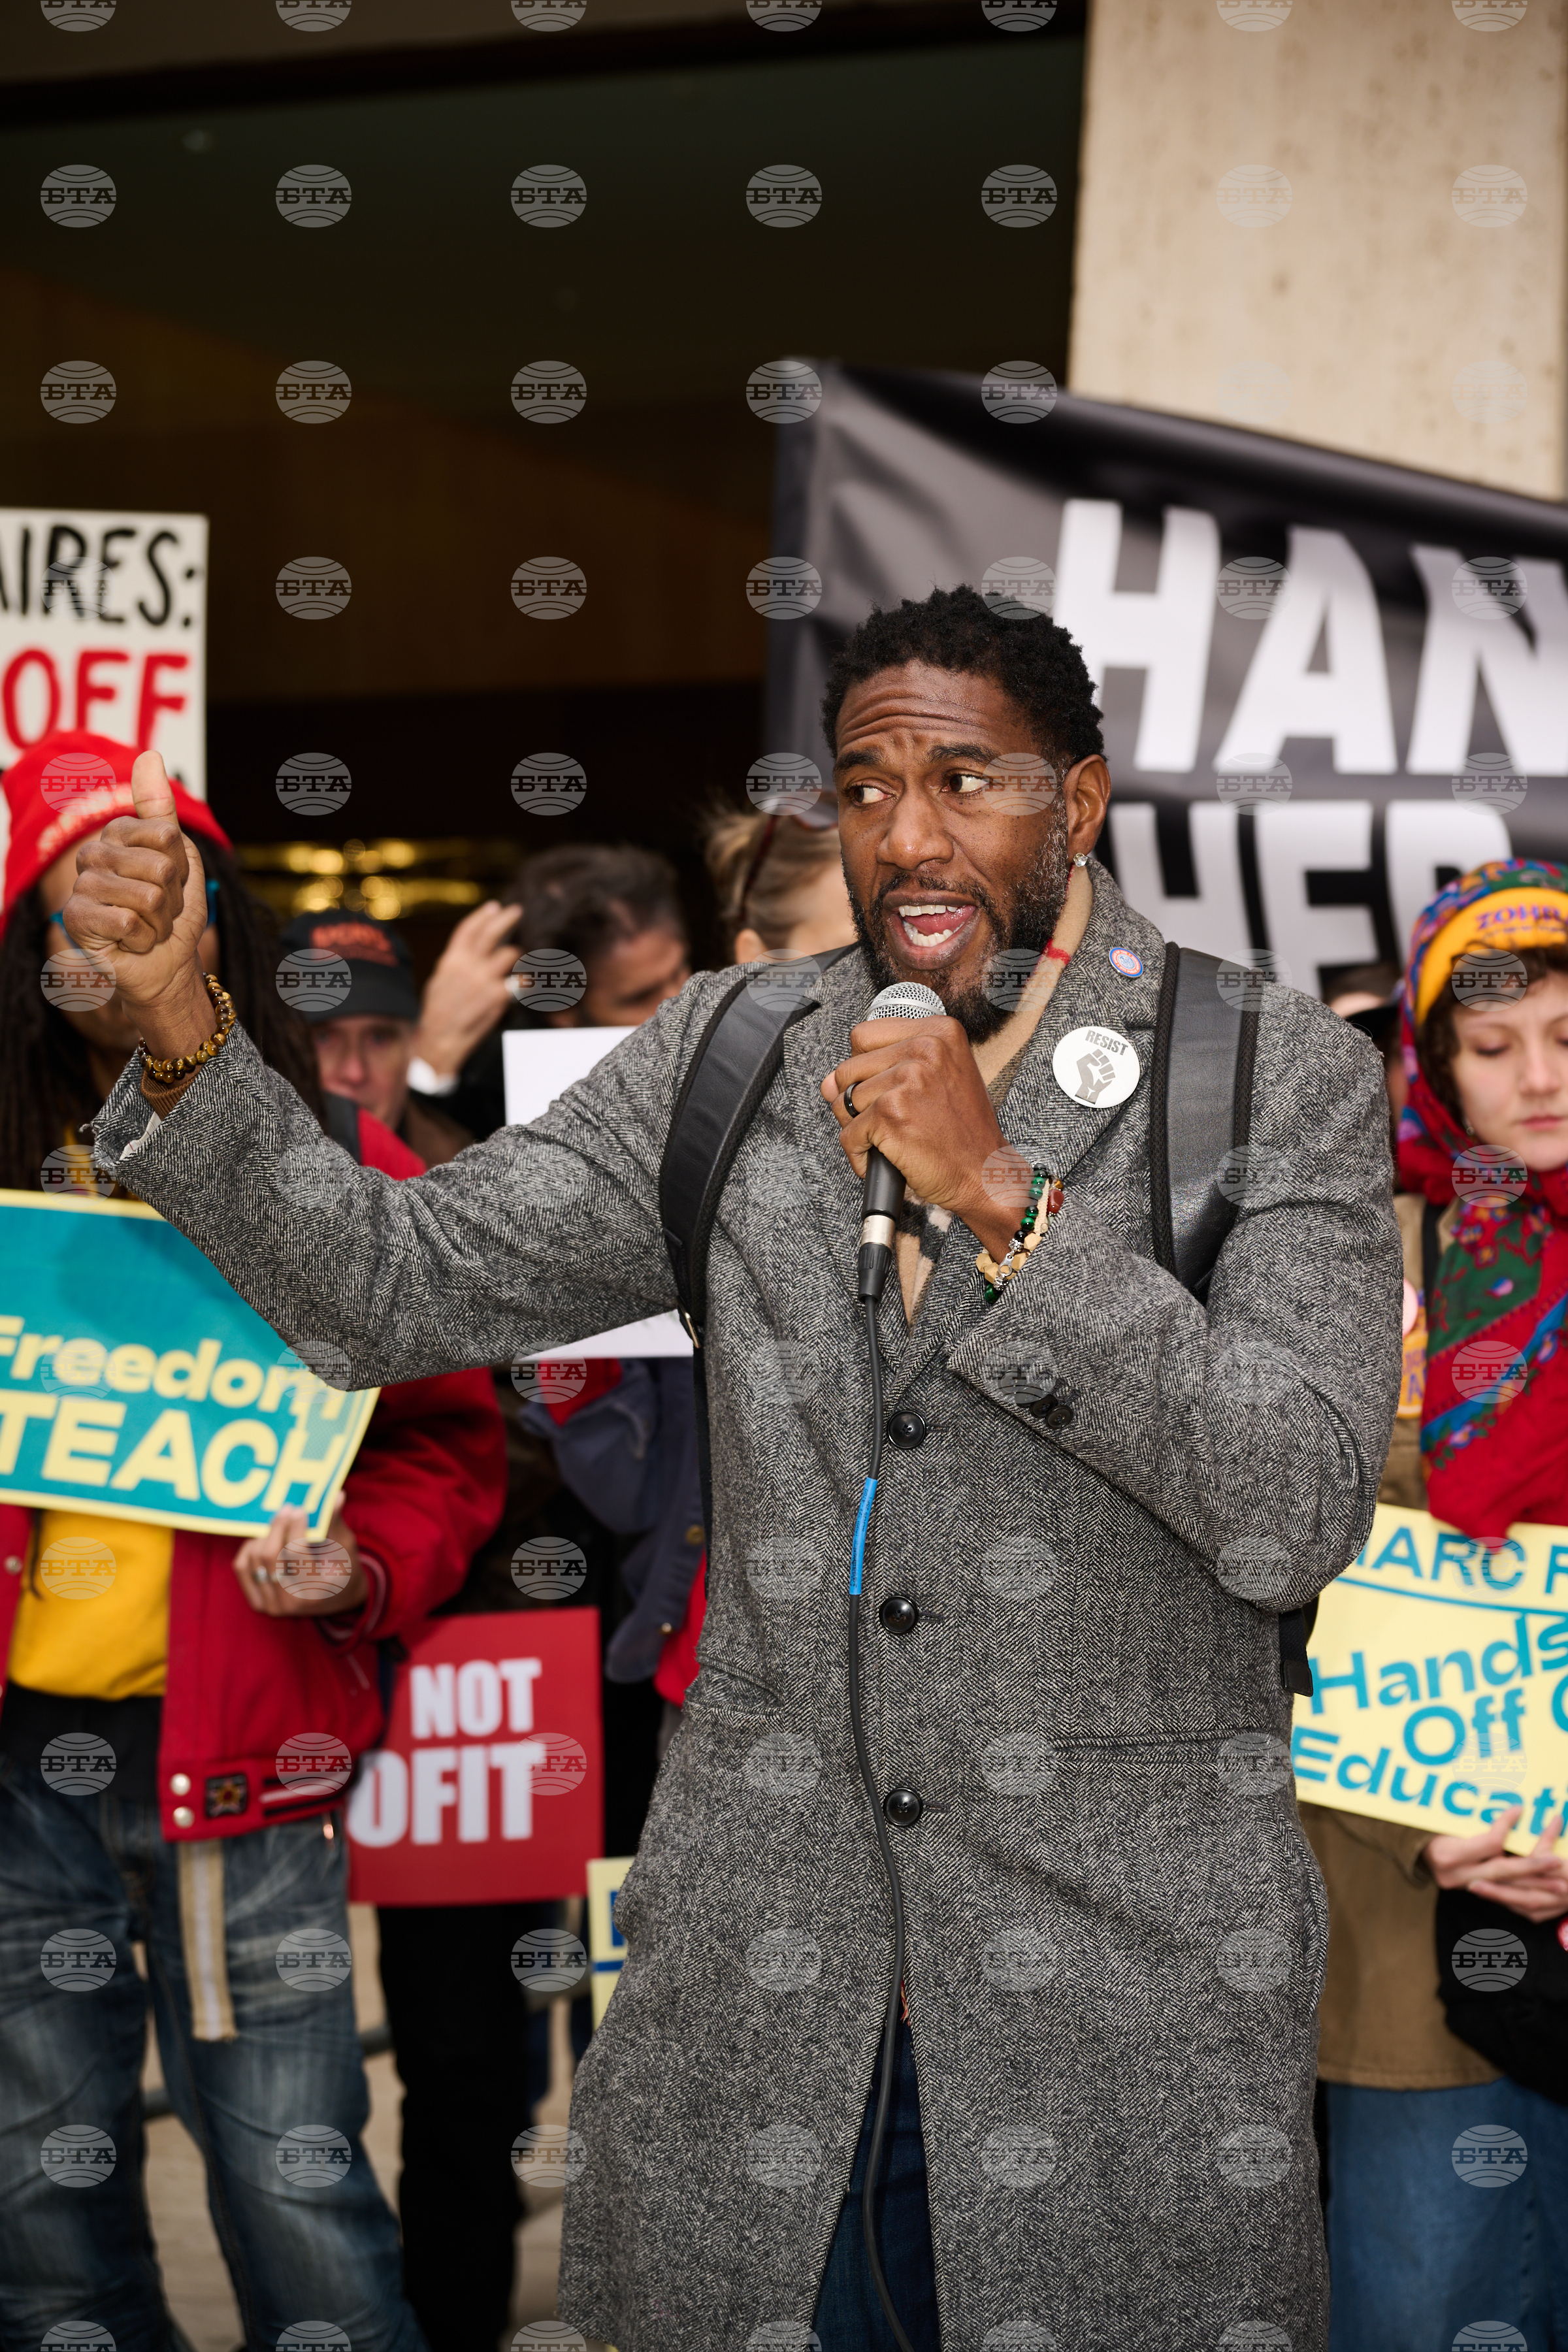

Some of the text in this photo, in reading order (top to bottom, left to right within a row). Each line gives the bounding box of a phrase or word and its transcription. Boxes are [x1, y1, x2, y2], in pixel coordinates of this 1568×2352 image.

[0, 525, 195, 627] IRES:
[1053, 498, 1568, 776] HAN
[2, 648, 189, 751] OFF
[1085, 1030, 1128, 1056] RESIST
[0, 1388, 348, 1514] TEACH
[1356, 1526, 1526, 1591] ARC
[410, 1658, 542, 1739] NOT
[1309, 1613, 1568, 1716] Hands
[1403, 1688, 1526, 1765] Off
